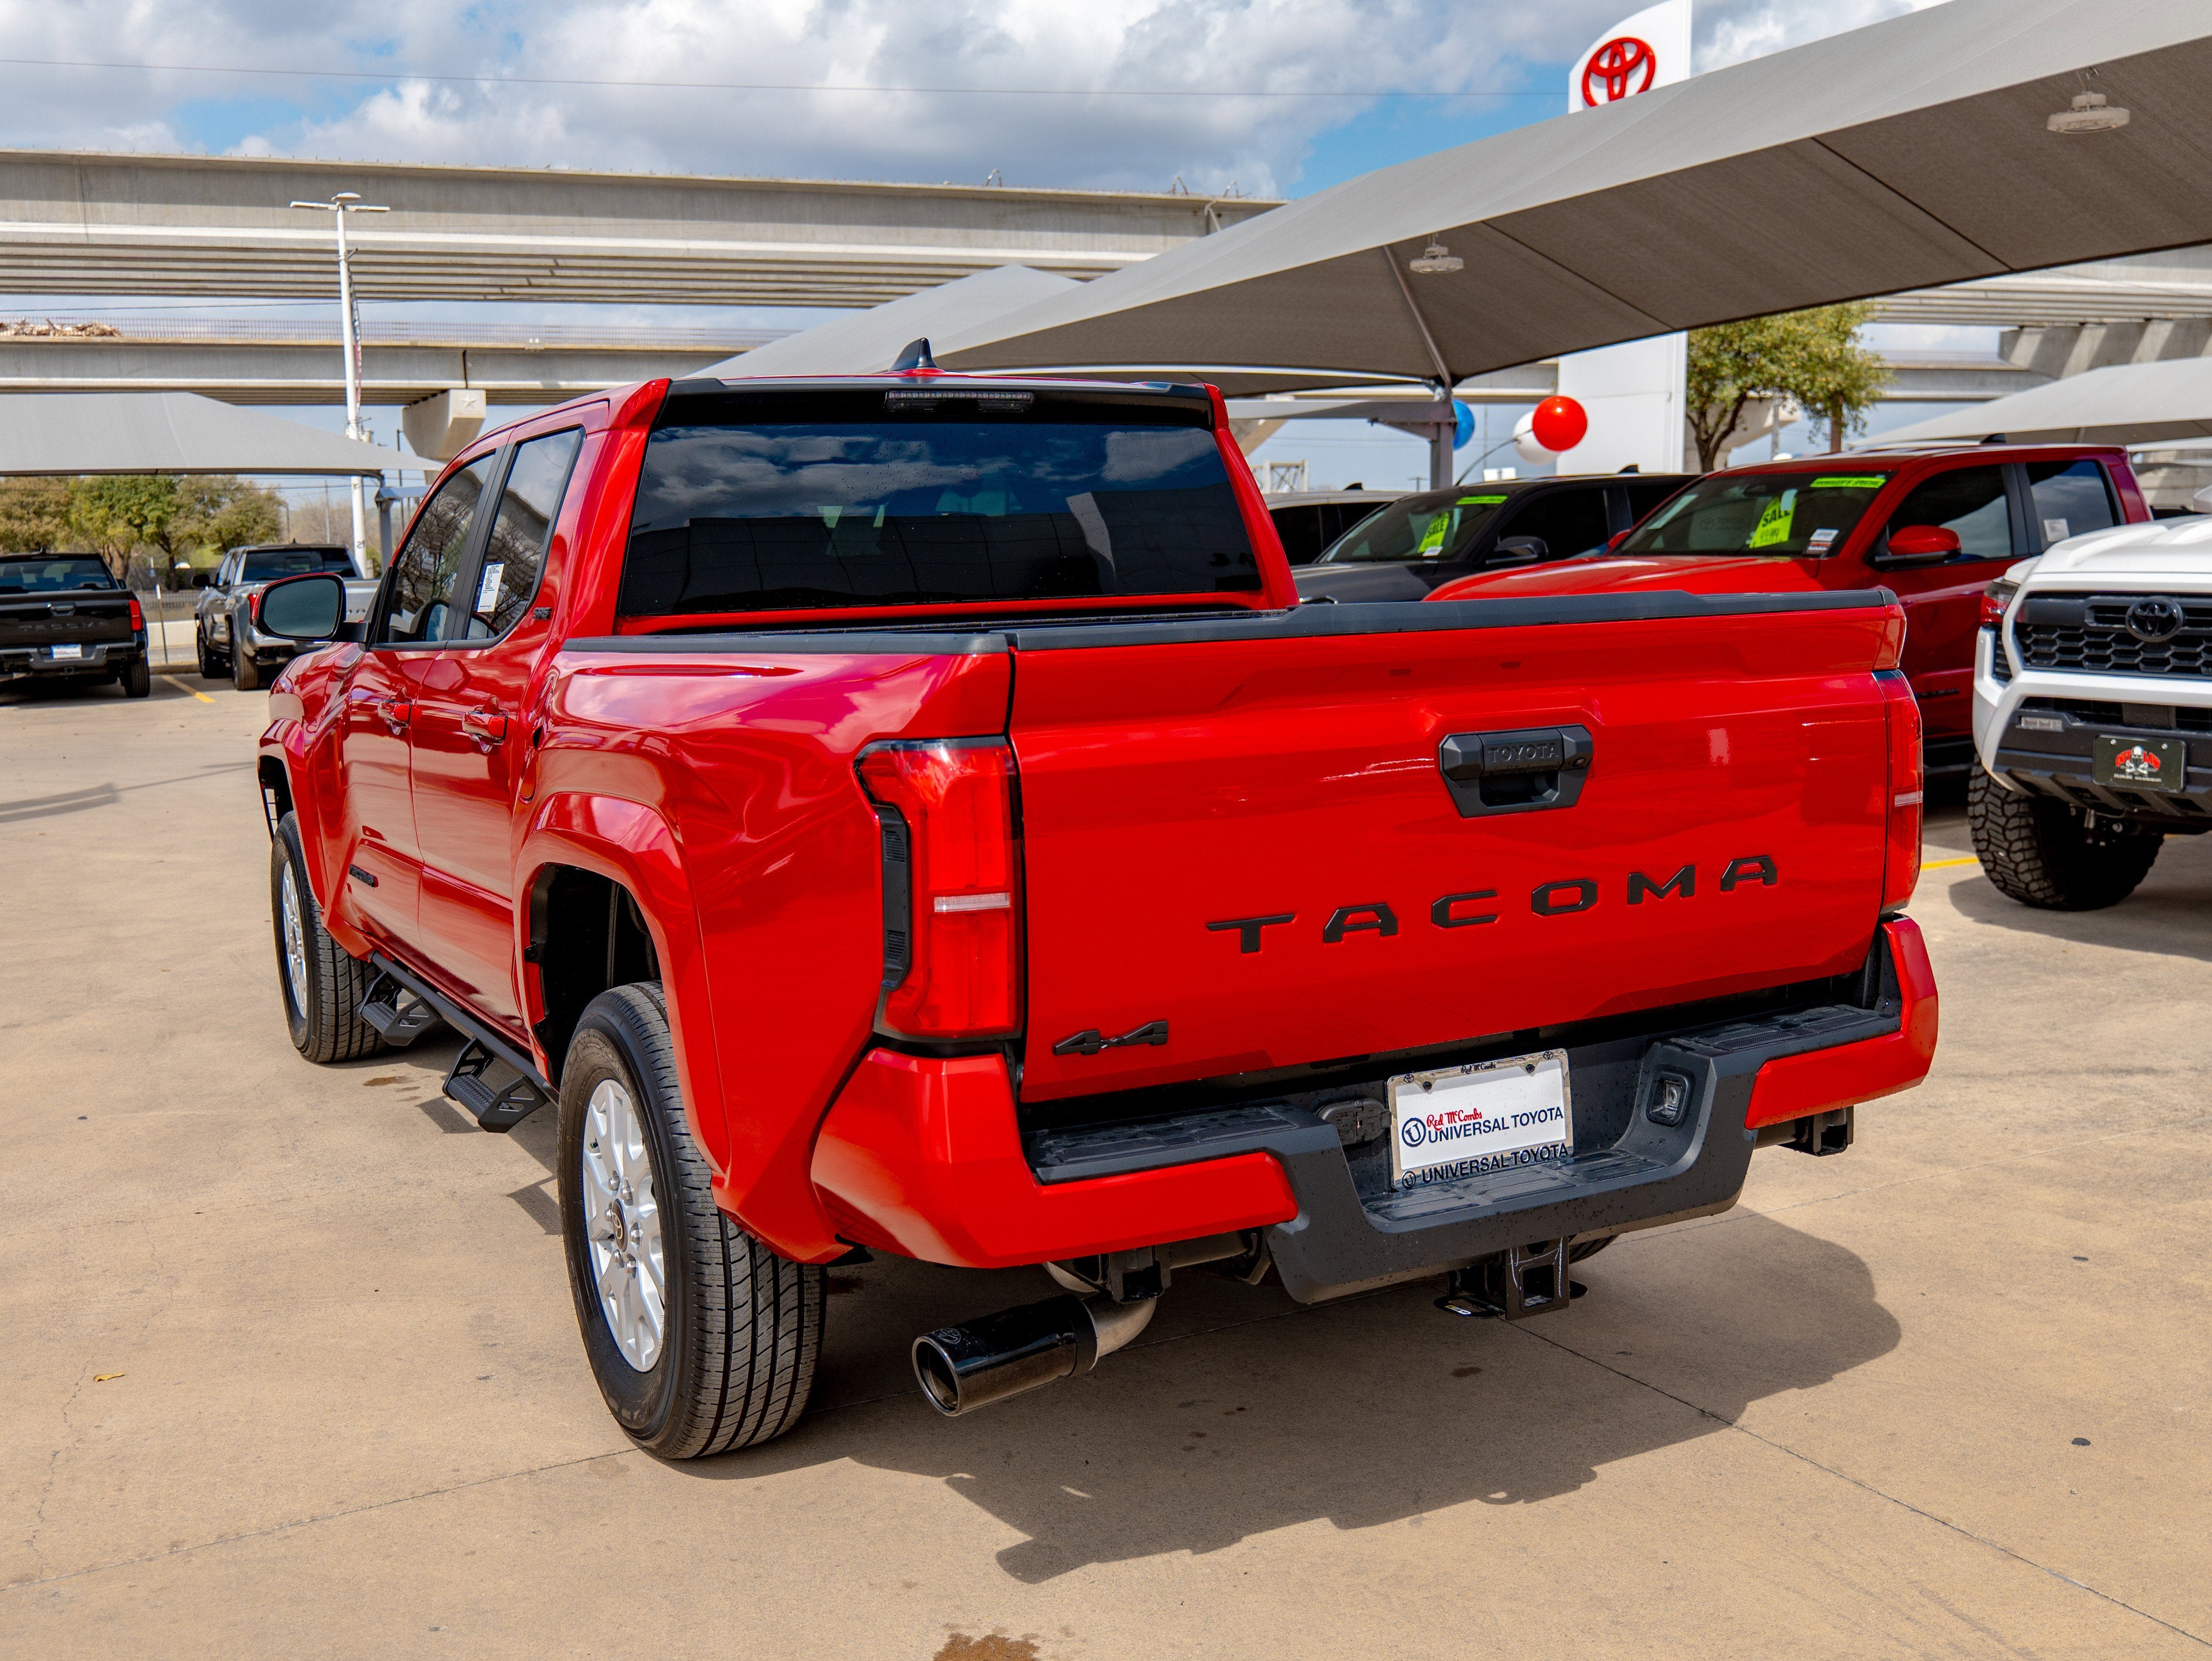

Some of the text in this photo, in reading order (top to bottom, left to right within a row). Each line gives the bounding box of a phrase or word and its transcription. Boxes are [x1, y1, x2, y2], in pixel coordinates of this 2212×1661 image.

[1487, 742, 1560, 763] TOYOTA
[1206, 854, 1779, 954] TACOMA
[1427, 1107, 1483, 1131] Red McCombs
[1428, 1106, 1563, 1143] UNIVERSAL TOYOTA
[1421, 1142, 1569, 1183] UNIVERSAL TOYOTA
